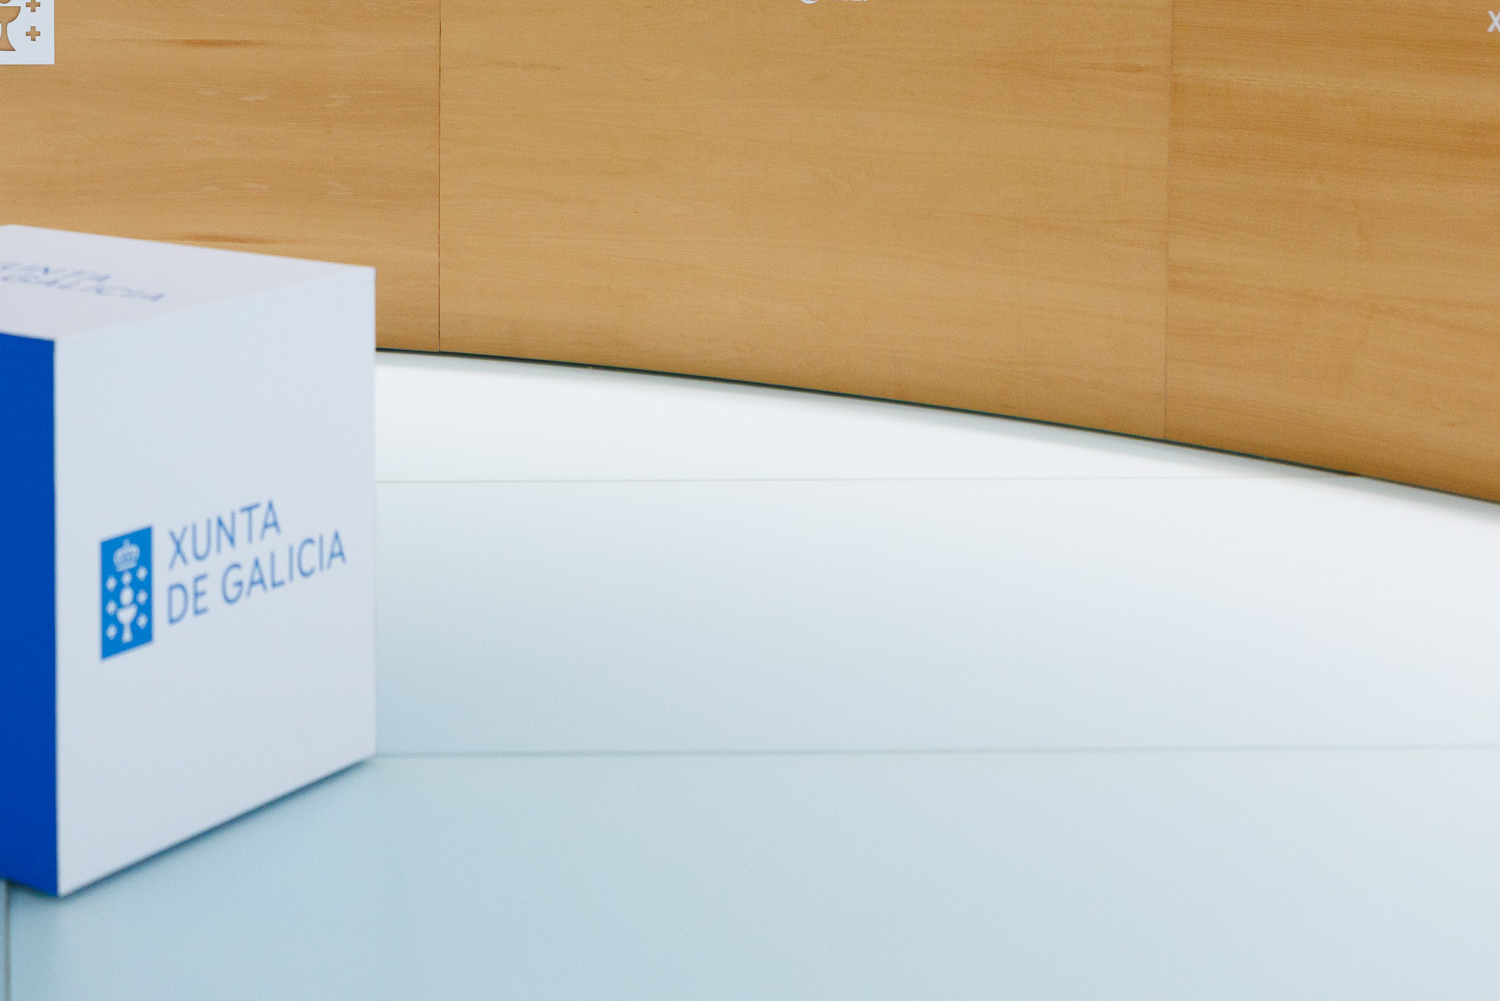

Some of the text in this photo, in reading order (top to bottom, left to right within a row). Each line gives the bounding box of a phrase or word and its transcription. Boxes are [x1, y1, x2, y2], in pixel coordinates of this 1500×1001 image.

[0, 273, 165, 302] GALICIA
[168, 498, 281, 571] XUNTA
[168, 528, 346, 626] DE GALICIA
